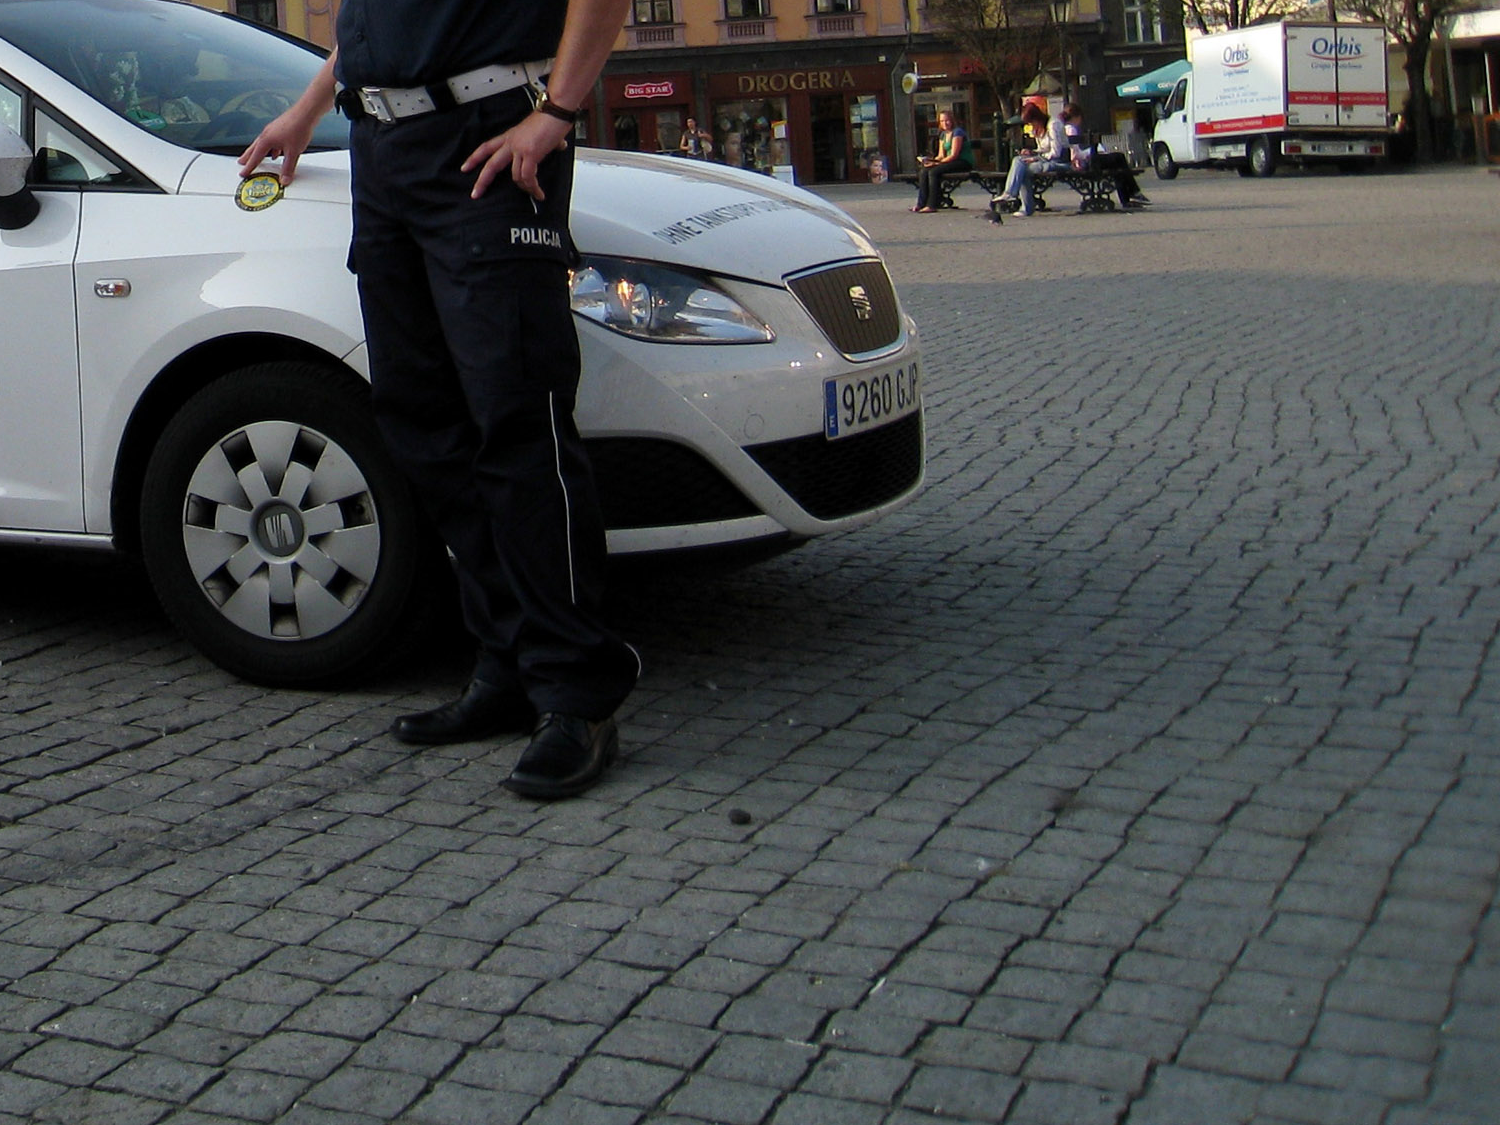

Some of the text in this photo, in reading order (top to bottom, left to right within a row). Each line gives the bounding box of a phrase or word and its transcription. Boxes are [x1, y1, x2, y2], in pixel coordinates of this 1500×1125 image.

[1223, 43, 1249, 63] Orbis
[1311, 36, 1362, 56] Orbis
[627, 85, 670, 95] BIG STAR
[738, 70, 856, 94] DROGERIA
[510, 227, 562, 249] POLICJA
[652, 220, 702, 246] OHNE
[842, 373, 892, 427] 9260
[896, 362, 918, 410] GJP
